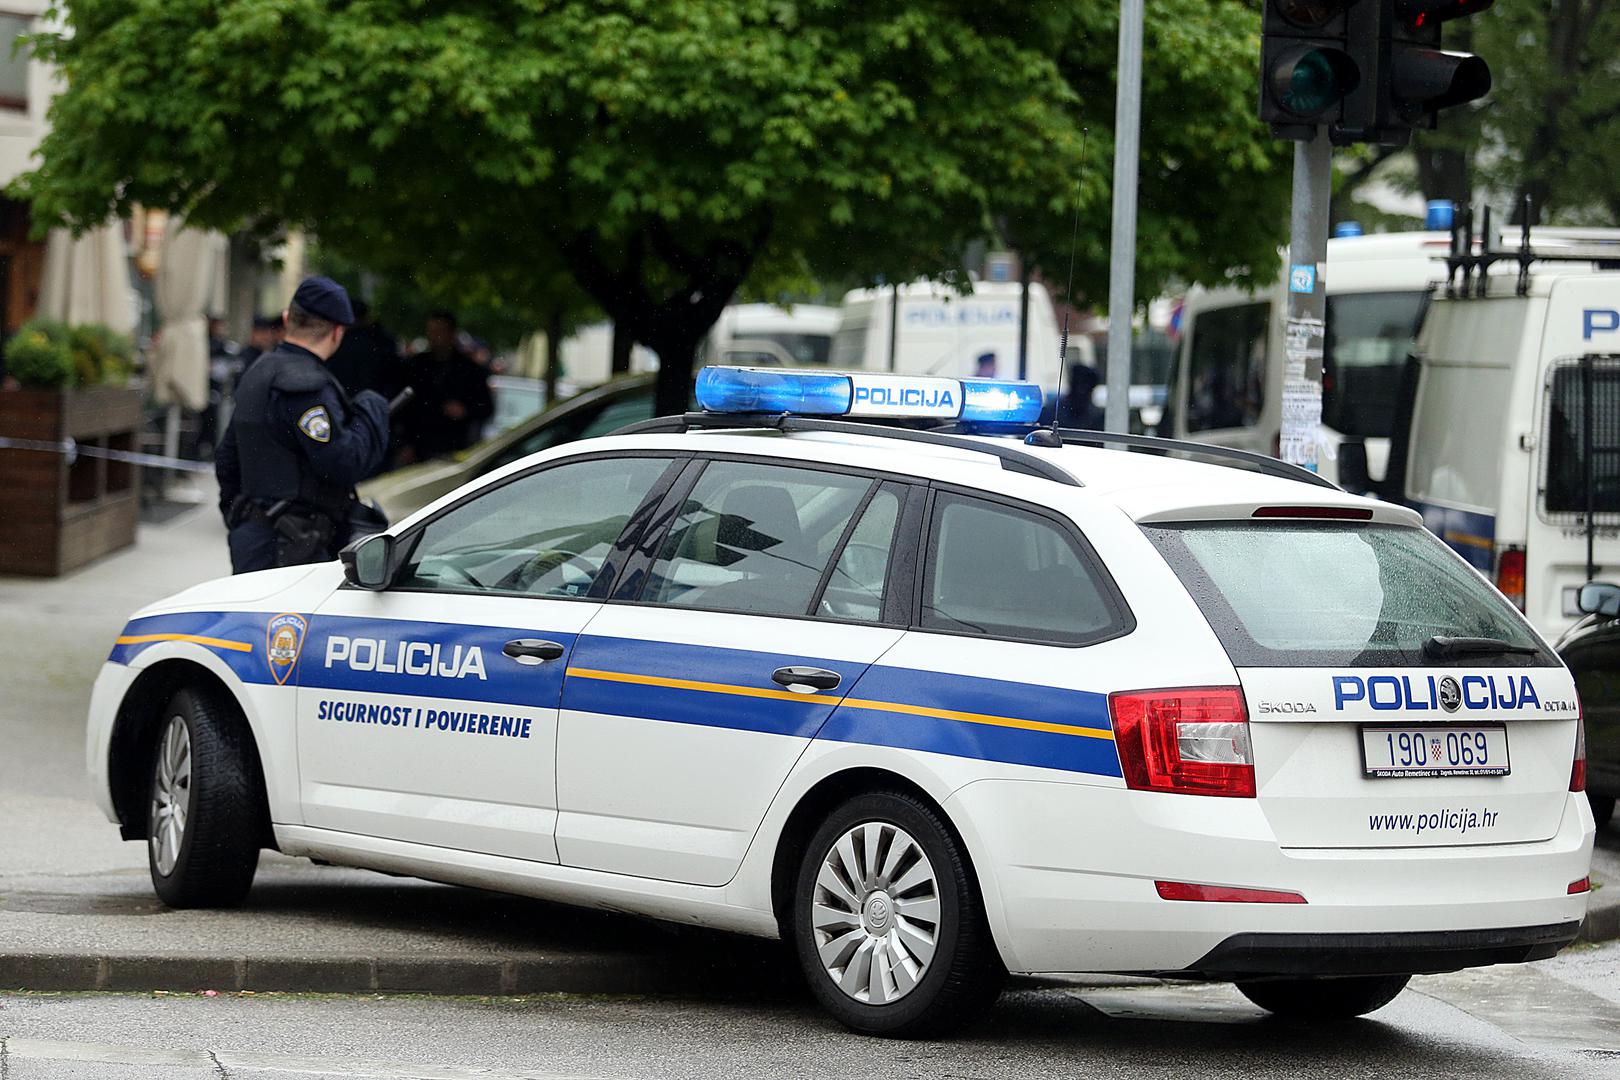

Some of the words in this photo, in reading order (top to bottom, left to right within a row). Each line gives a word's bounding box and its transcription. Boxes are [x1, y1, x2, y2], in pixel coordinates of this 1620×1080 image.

[854, 386, 954, 408] POLICIJA
[325, 635, 488, 680] POLICIJA
[1332, 675, 1541, 711] POLICIJA
[318, 700, 412, 727] SIGURNOST
[414, 708, 421, 728] I
[425, 709, 533, 738] POVJERENJE
[1387, 732, 1427, 766] 190
[1446, 732, 1488, 766] 069
[1369, 808, 1499, 835] www.policija.hr
